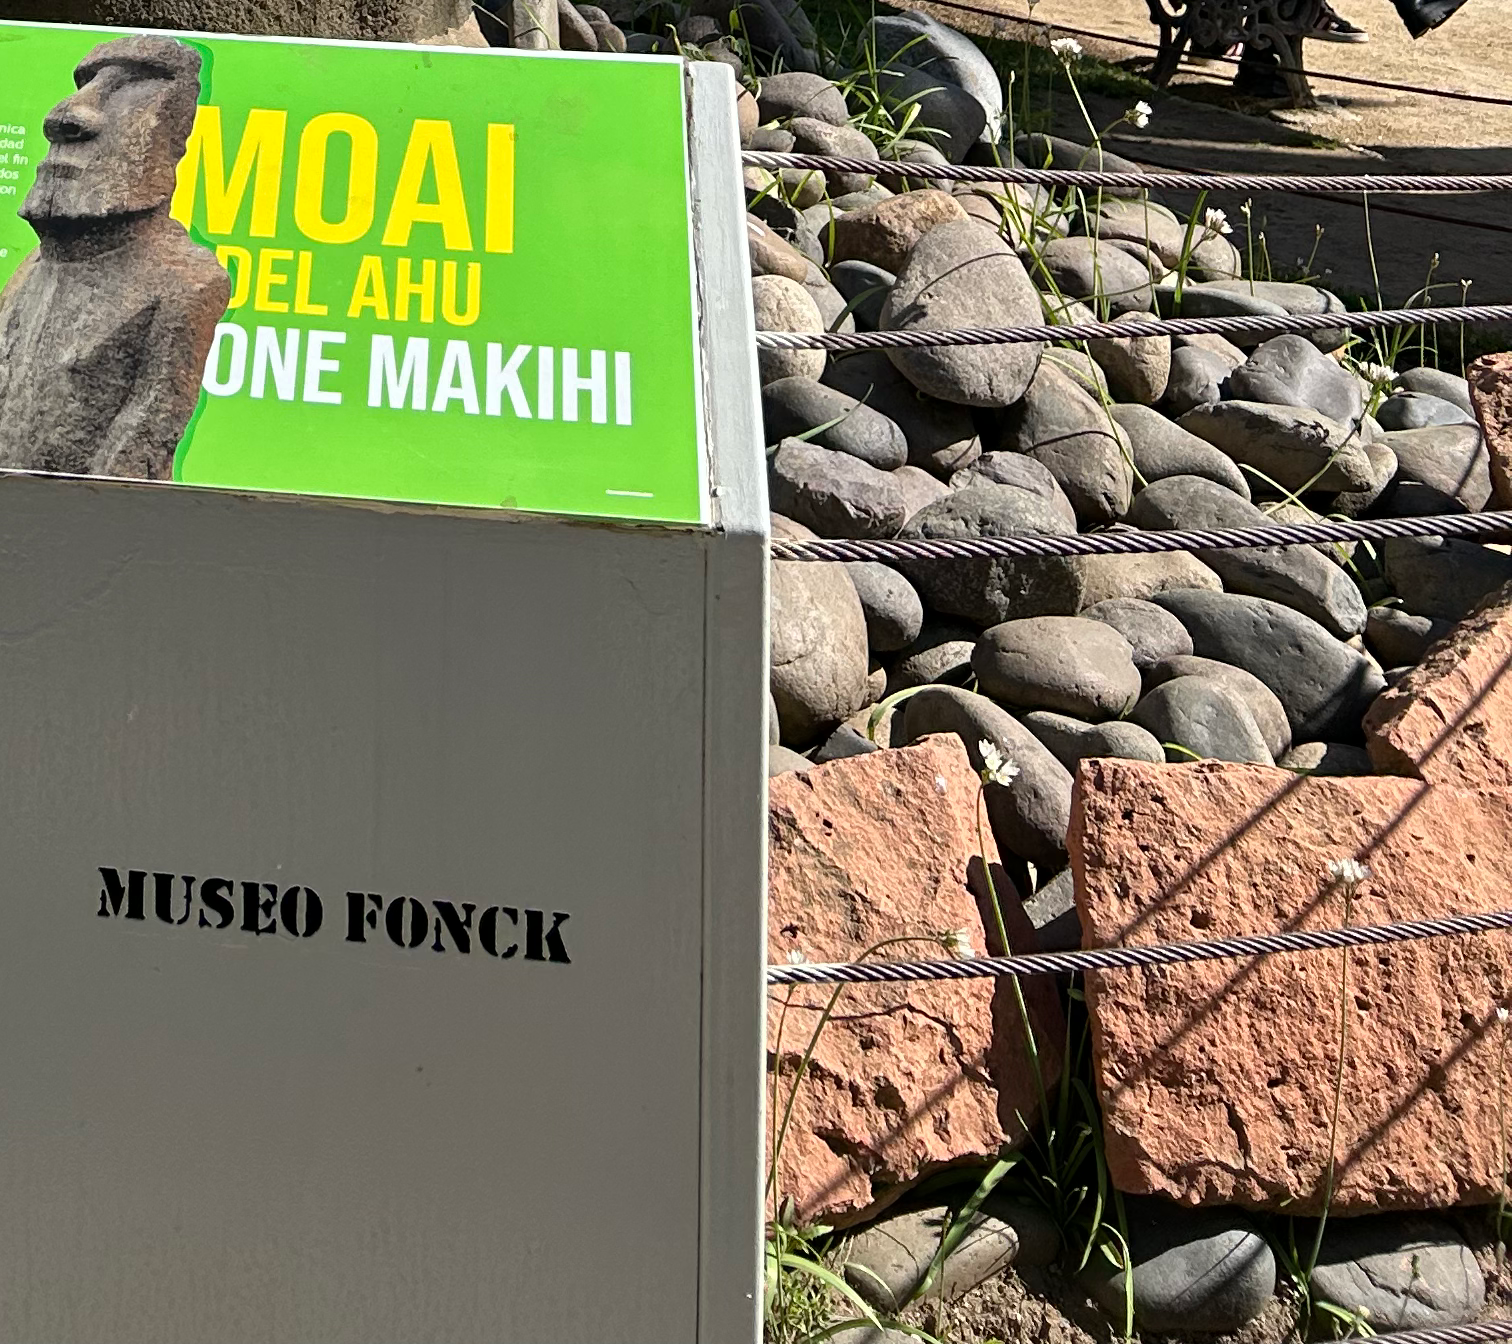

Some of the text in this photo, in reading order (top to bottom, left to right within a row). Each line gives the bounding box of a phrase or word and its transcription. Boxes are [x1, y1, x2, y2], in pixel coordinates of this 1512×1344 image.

[13, 153, 28, 165] fin
[170, 105, 515, 254] MOAI
[216, 245, 481, 326] DEL AHU
[202, 322, 632, 426] ONE MAKIHI
[97, 867, 572, 964] MUSEO FONCK
